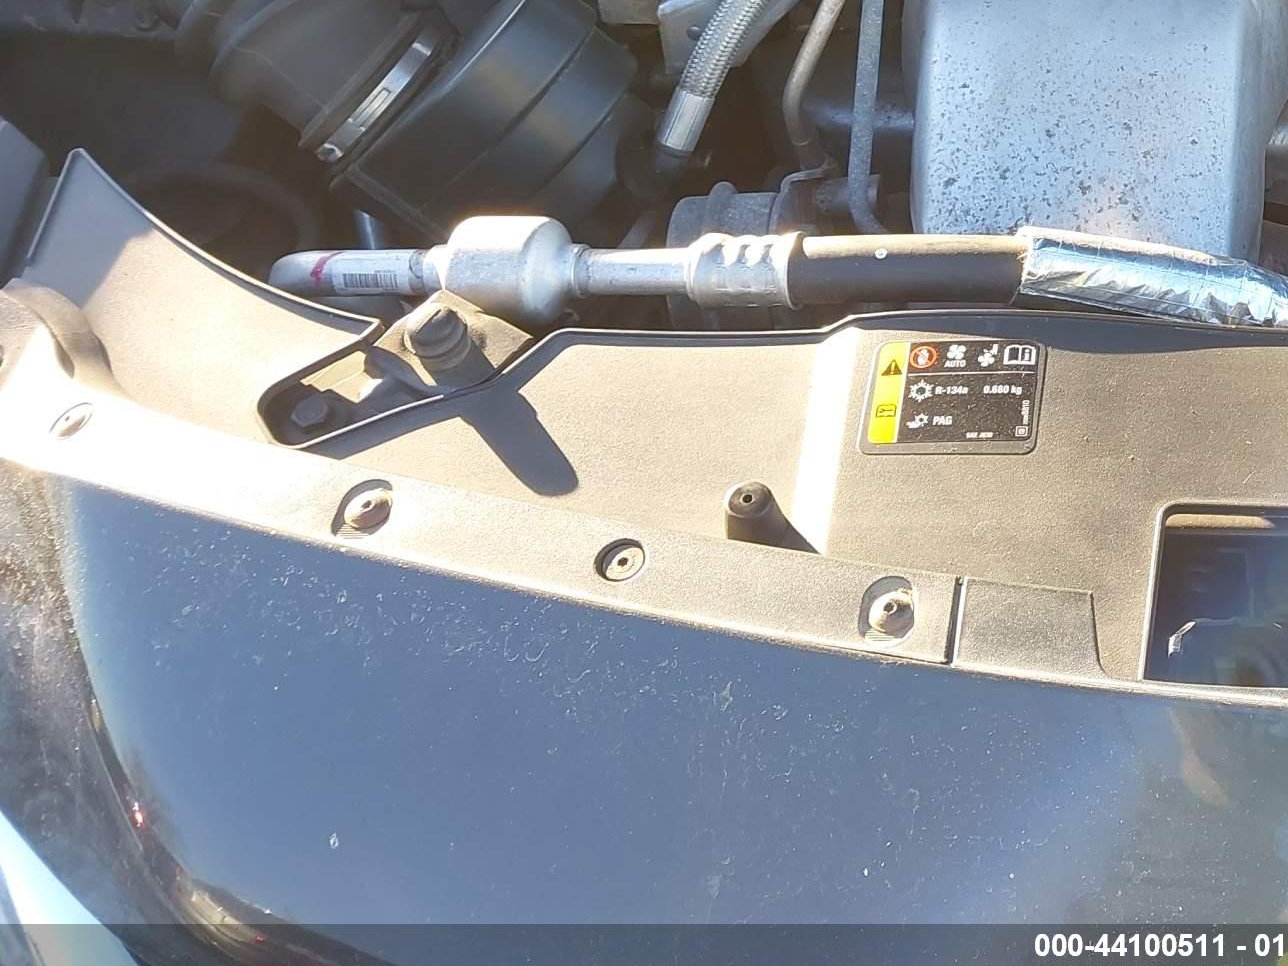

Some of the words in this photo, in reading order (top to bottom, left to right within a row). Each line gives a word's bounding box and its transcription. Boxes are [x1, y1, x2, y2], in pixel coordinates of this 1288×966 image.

[944, 360, 967, 368] AUTO
[934, 385, 969, 395] R-134a
[1010, 384, 1023, 396] kg
[932, 415, 953, 426] PAG
